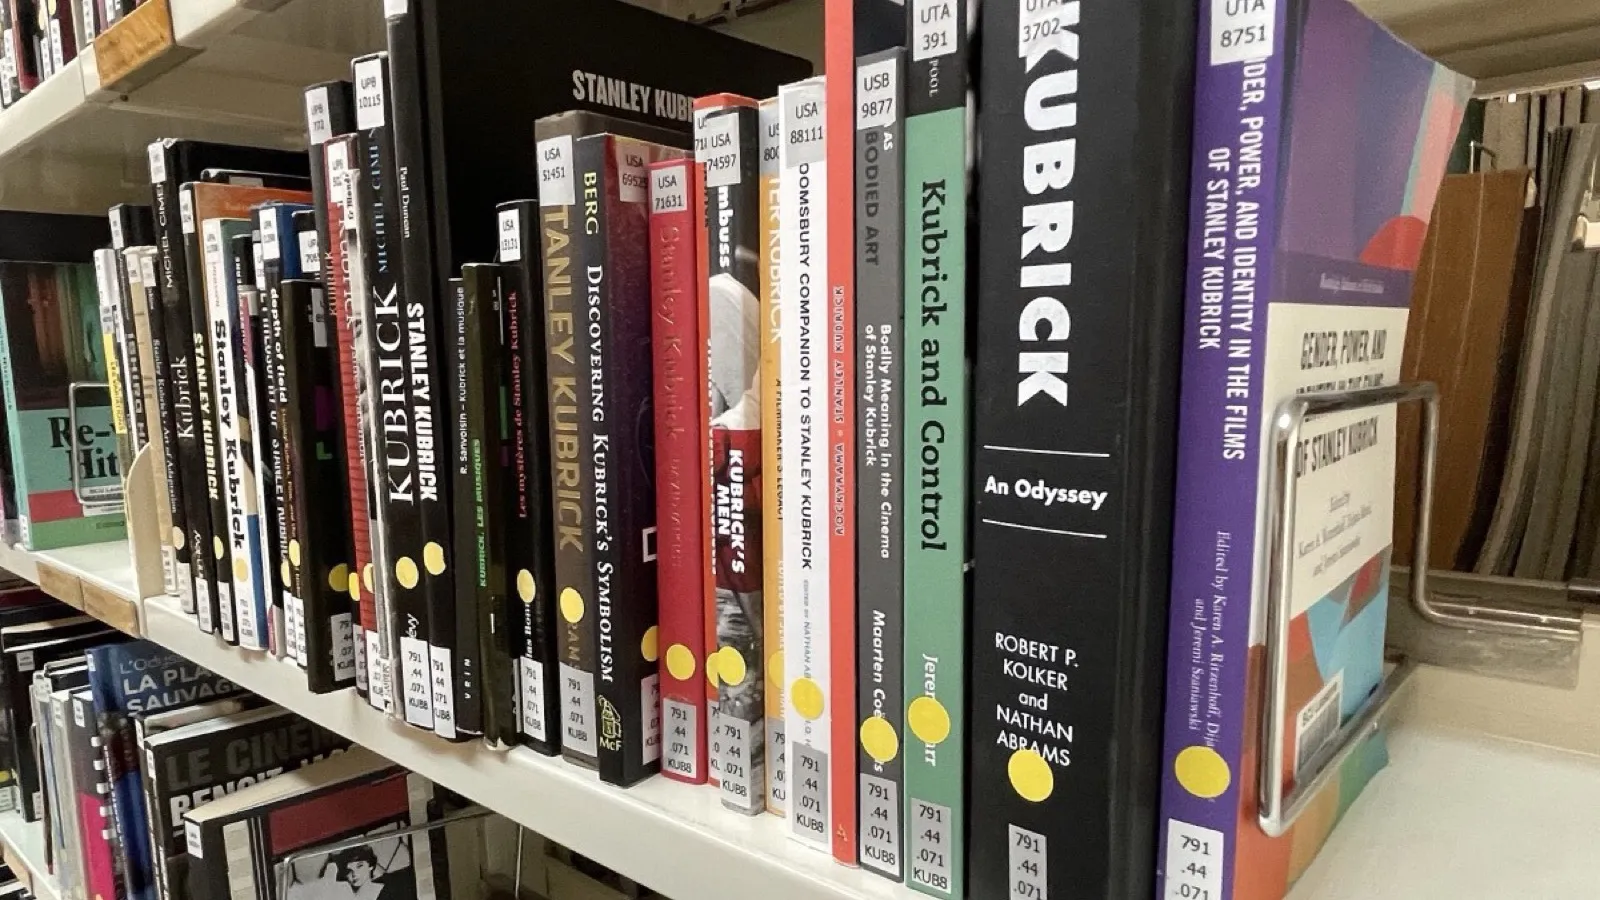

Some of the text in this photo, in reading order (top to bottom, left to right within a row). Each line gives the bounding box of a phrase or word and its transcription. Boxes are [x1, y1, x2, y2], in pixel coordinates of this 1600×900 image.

[921, 5, 950, 23] UTA
[1226, 0, 1265, 15] UTA
[923, 32, 948, 50] 391
[1023, 18, 1060, 43] 3702
[1220, 25, 1266, 48] 8751
[573, 70, 650, 114] STANLEY
[864, 72, 890, 91] USB
[795, 102, 818, 118] USA
[861, 98, 892, 118] 9877
[712, 133, 730, 147] USA
[790, 128, 823, 145] 88111
[884, 132, 893, 150] AS
[545, 148, 560, 161] USA
[626, 154, 643, 168] USA
[708, 154, 736, 171] 74597
[1235, 116, 1263, 194] POWER,
[658, 176, 677, 190] USA
[400, 167, 410, 238] Paul Duncan
[583, 172, 598, 235] BERG
[655, 196, 682, 211] 71631
[865, 132, 879, 265] BODIED ART
[1017, 0, 1080, 407] KUBRICK
[1236, 202, 1260, 240] AND
[1198, 146, 1230, 350] OF STANLEY KUBRICK
[657, 226, 682, 325] Stanley
[1230, 247, 1257, 332] IDENTITY
[457, 287, 465, 334] musique
[508, 292, 518, 350] Kubrick
[270, 288, 287, 403] depth of field
[457, 337, 465, 346] la
[1228, 339, 1251, 358] IN
[459, 349, 465, 359] et
[920, 179, 948, 551] Kubrick and Control
[458, 363, 466, 402] Kubrick
[512, 355, 521, 406] Stanley
[545, 205, 583, 552] TANLEY KUBRICK
[664, 336, 684, 440] Kubrick
[1226, 365, 1250, 398] THE
[171, 356, 194, 439] Kubrick
[373, 282, 413, 506] KUBRICK
[407, 303, 437, 501] STANLEY KUBRICK
[863, 325, 877, 466] of Stanley Kubrick
[193, 333, 219, 500] STANLEY KUBRICK
[514, 409, 521, 427] de
[800, 273, 812, 570] COMPANION TO STANLEY KUBRICK
[215, 320, 232, 429] Stanley
[226, 438, 246, 549] Kubrick
[879, 325, 892, 559] Bodily Meaning in the Cinema
[1223, 405, 1248, 460] FILMS
[587, 266, 613, 683] DISCOVERING KUBRICK'S SYMBOLISM
[985, 475, 1107, 510] An Odyssey
[717, 484, 731, 535] MEN
[729, 450, 744, 574] KUBRICK'S
[1215, 531, 1231, 577] Edited
[1211, 580, 1229, 596] by
[1193, 598, 1207, 620] and
[1212, 595, 1227, 631] Karen
[804, 621, 812, 664] NATHAN
[873, 610, 885, 684] Maarten
[996, 632, 1079, 667] ROBERT P.
[1211, 633, 1225, 649] A.
[123, 674, 157, 695] LA
[1003, 659, 1067, 691] KOLKER
[1019, 693, 1048, 711] and
[670, 706, 687, 720] 791
[673, 726, 686, 738] .44
[725, 725, 741, 739] 791
[997, 705, 1072, 743] NATHAN
[600, 738, 622, 751] McF
[671, 742, 688, 755] .071
[726, 746, 740, 758] .44
[997, 730, 1070, 767] ABRAMS
[668, 758, 692, 773] KUB8
[724, 763, 743, 778] .071
[801, 755, 819, 772] 791
[723, 779, 747, 797] KUB8
[802, 777, 818, 792] .44
[868, 783, 888, 800] 791
[800, 795, 820, 813] .071
[870, 807, 888, 821] .44
[920, 805, 942, 823] 791
[796, 813, 824, 834] KUB8
[867, 826, 892, 843] .071
[920, 829, 940, 844] .44
[1015, 832, 1040, 854] 791
[1181, 835, 1210, 855] 791
[865, 844, 896, 866] KUB8
[917, 849, 944, 867] .071
[914, 867, 948, 890] KUB8
[1017, 861, 1038, 877] .44
[1181, 863, 1207, 878] .44
[1013, 881, 1042, 900] .071
[1175, 884, 1209, 900] .071
